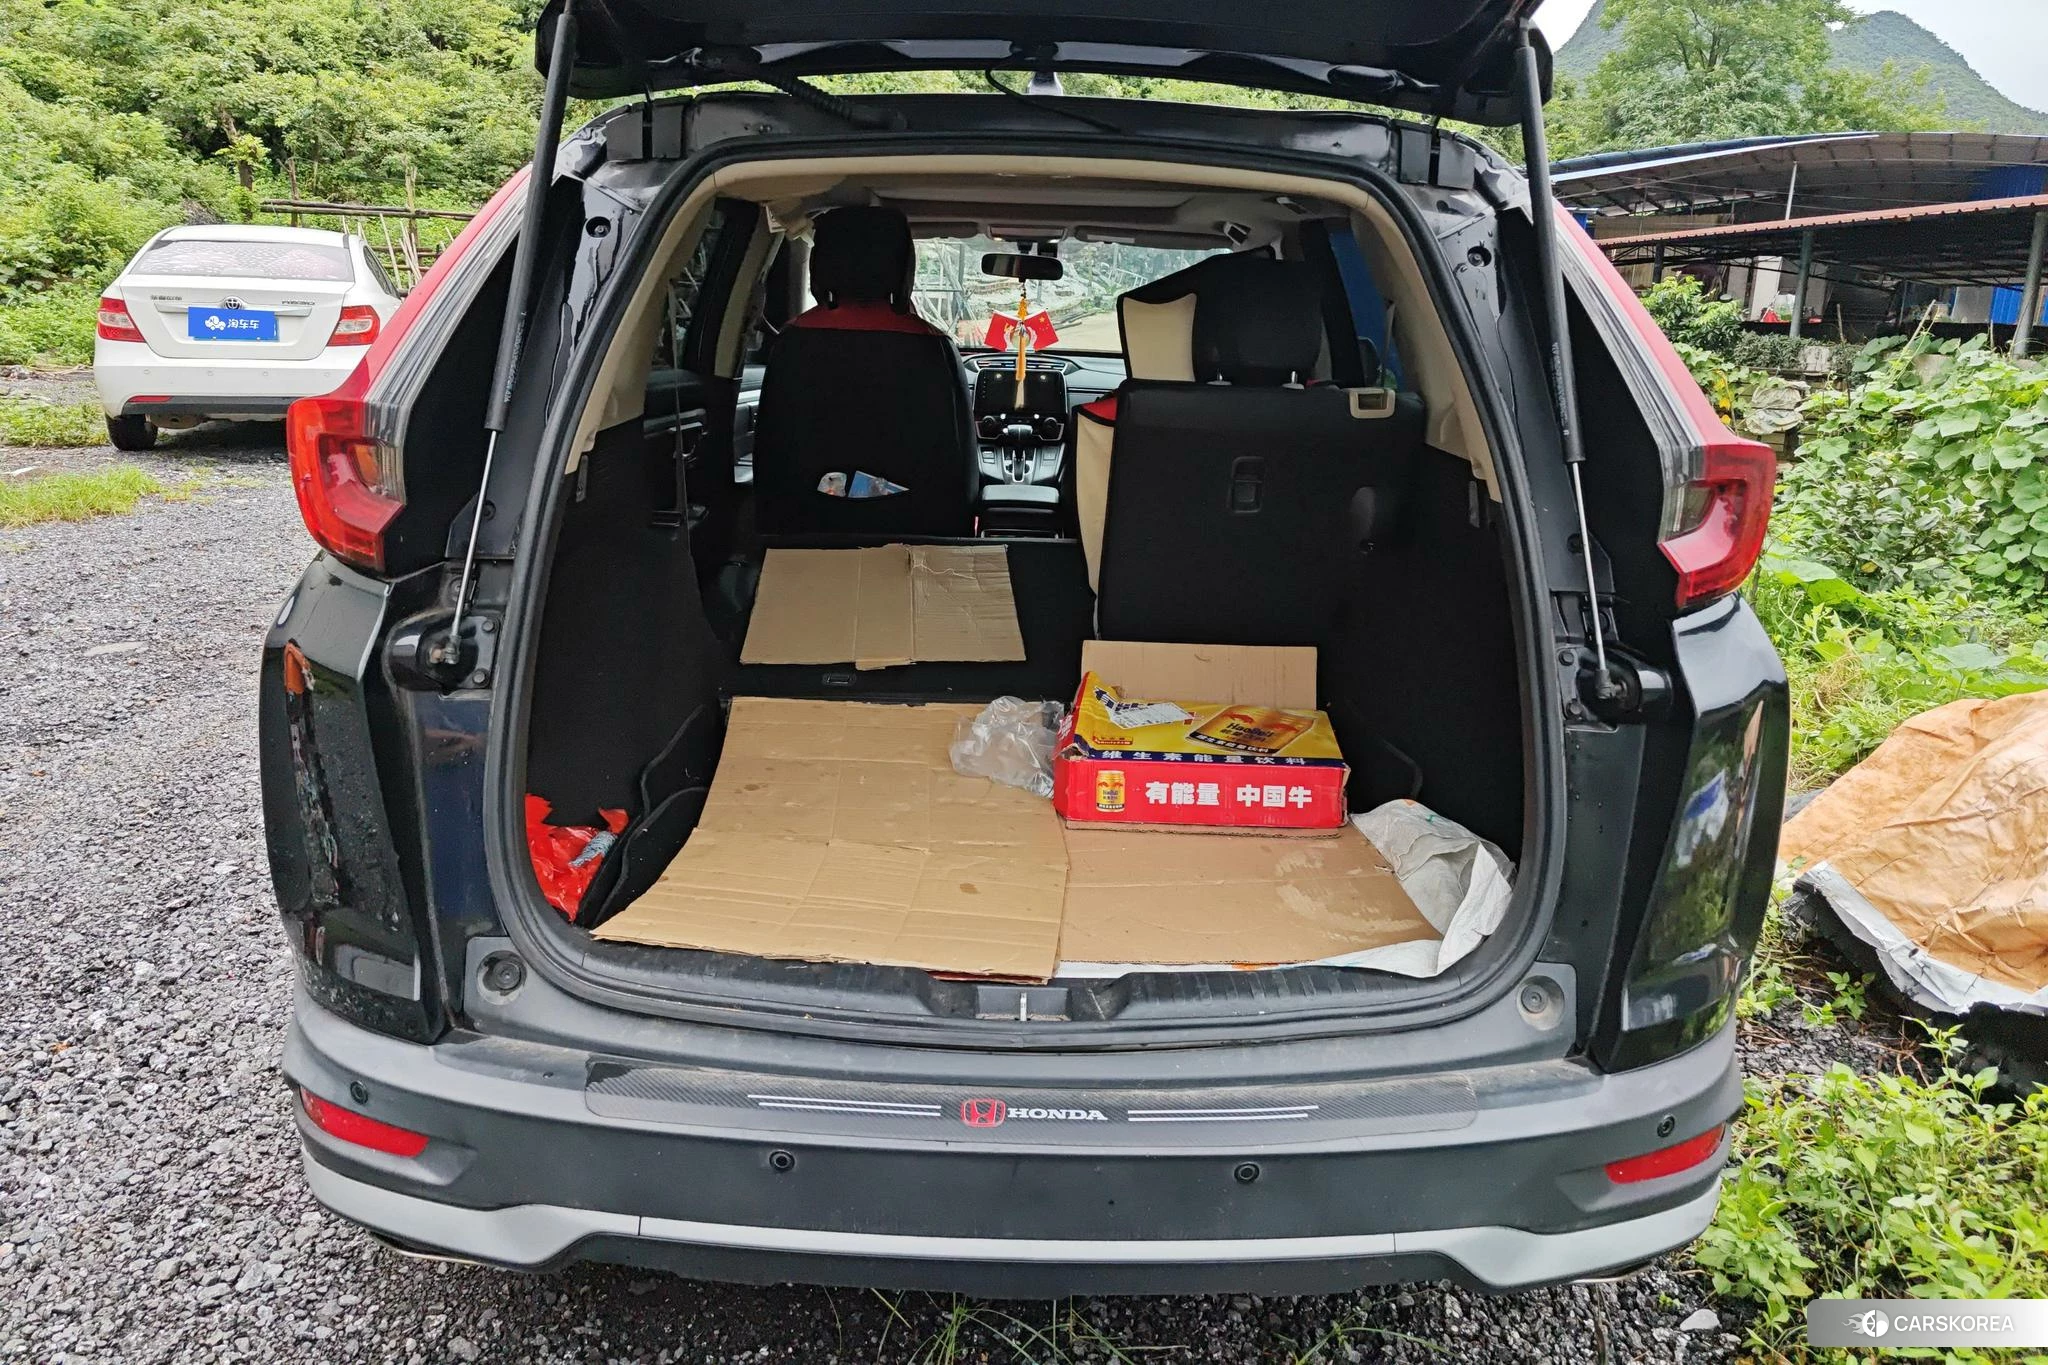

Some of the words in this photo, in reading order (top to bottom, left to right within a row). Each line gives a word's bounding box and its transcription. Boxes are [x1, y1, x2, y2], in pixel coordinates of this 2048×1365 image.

[1102, 750, 1306, 766] 维生素能量饮料
[1145, 782, 1220, 806] 有能量
[1236, 784, 1313, 809] 中国牛
[1007, 1107, 1108, 1121] HONDA
